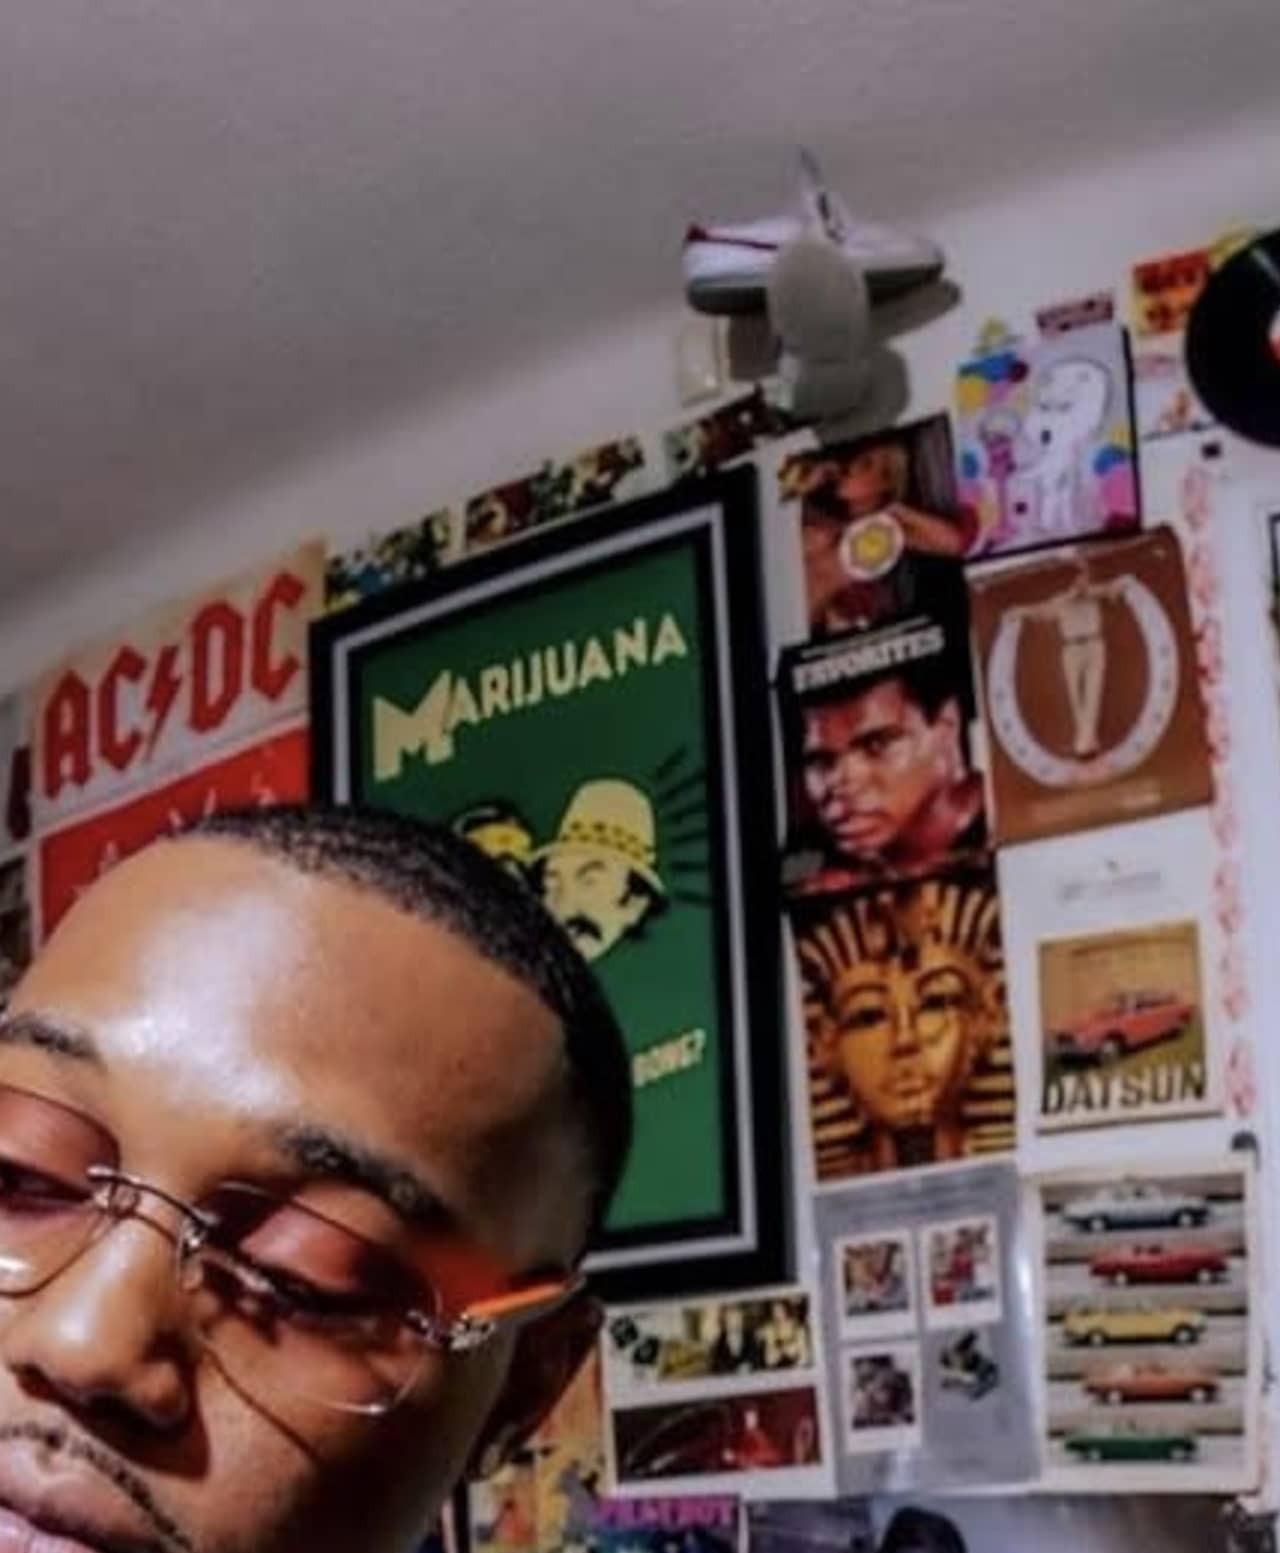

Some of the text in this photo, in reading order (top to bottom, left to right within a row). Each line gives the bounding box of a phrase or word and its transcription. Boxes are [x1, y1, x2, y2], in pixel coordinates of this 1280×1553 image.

[42, 570, 308, 800] AC/DC
[372, 612, 689, 782] MARIJUANA
[1041, 1060, 1208, 1117] DATSUN
